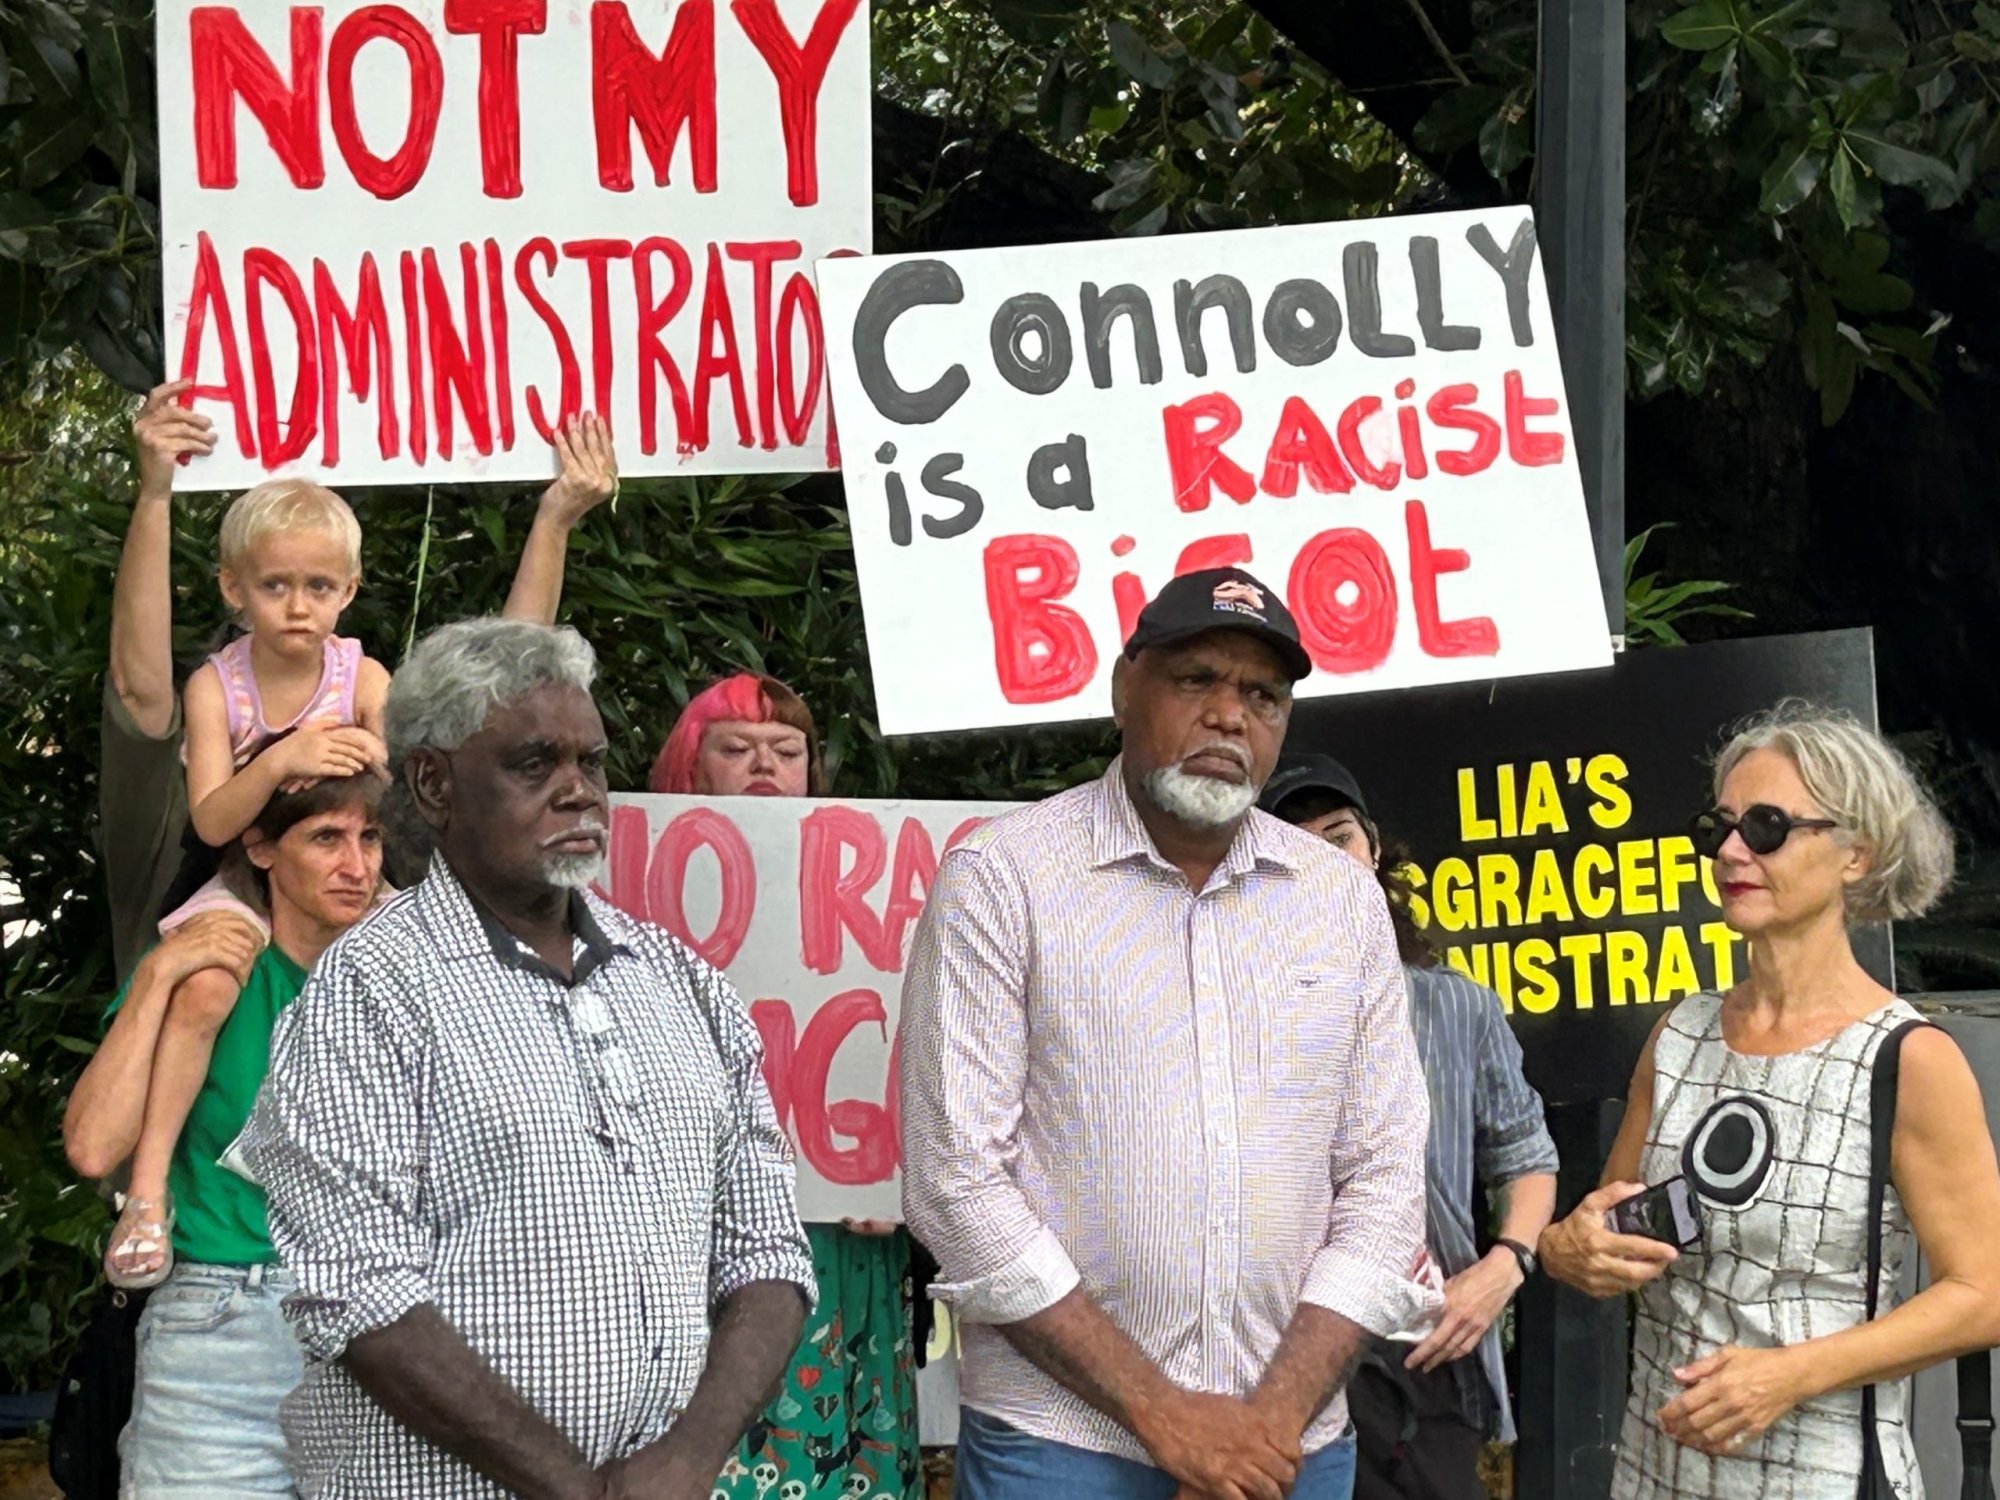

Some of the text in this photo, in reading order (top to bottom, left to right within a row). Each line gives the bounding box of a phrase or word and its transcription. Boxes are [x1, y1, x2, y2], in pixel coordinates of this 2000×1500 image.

[190, 0, 866, 207] NOT MY
[176, 230, 866, 470] ADMINISTRATO
[875, 441, 984, 546] is
[1027, 433, 1094, 511] a
[1457, 754, 1633, 842] LIA'S
[799, 804, 987, 976] RA
[1446, 921, 1753, 1016] NISTRAT
